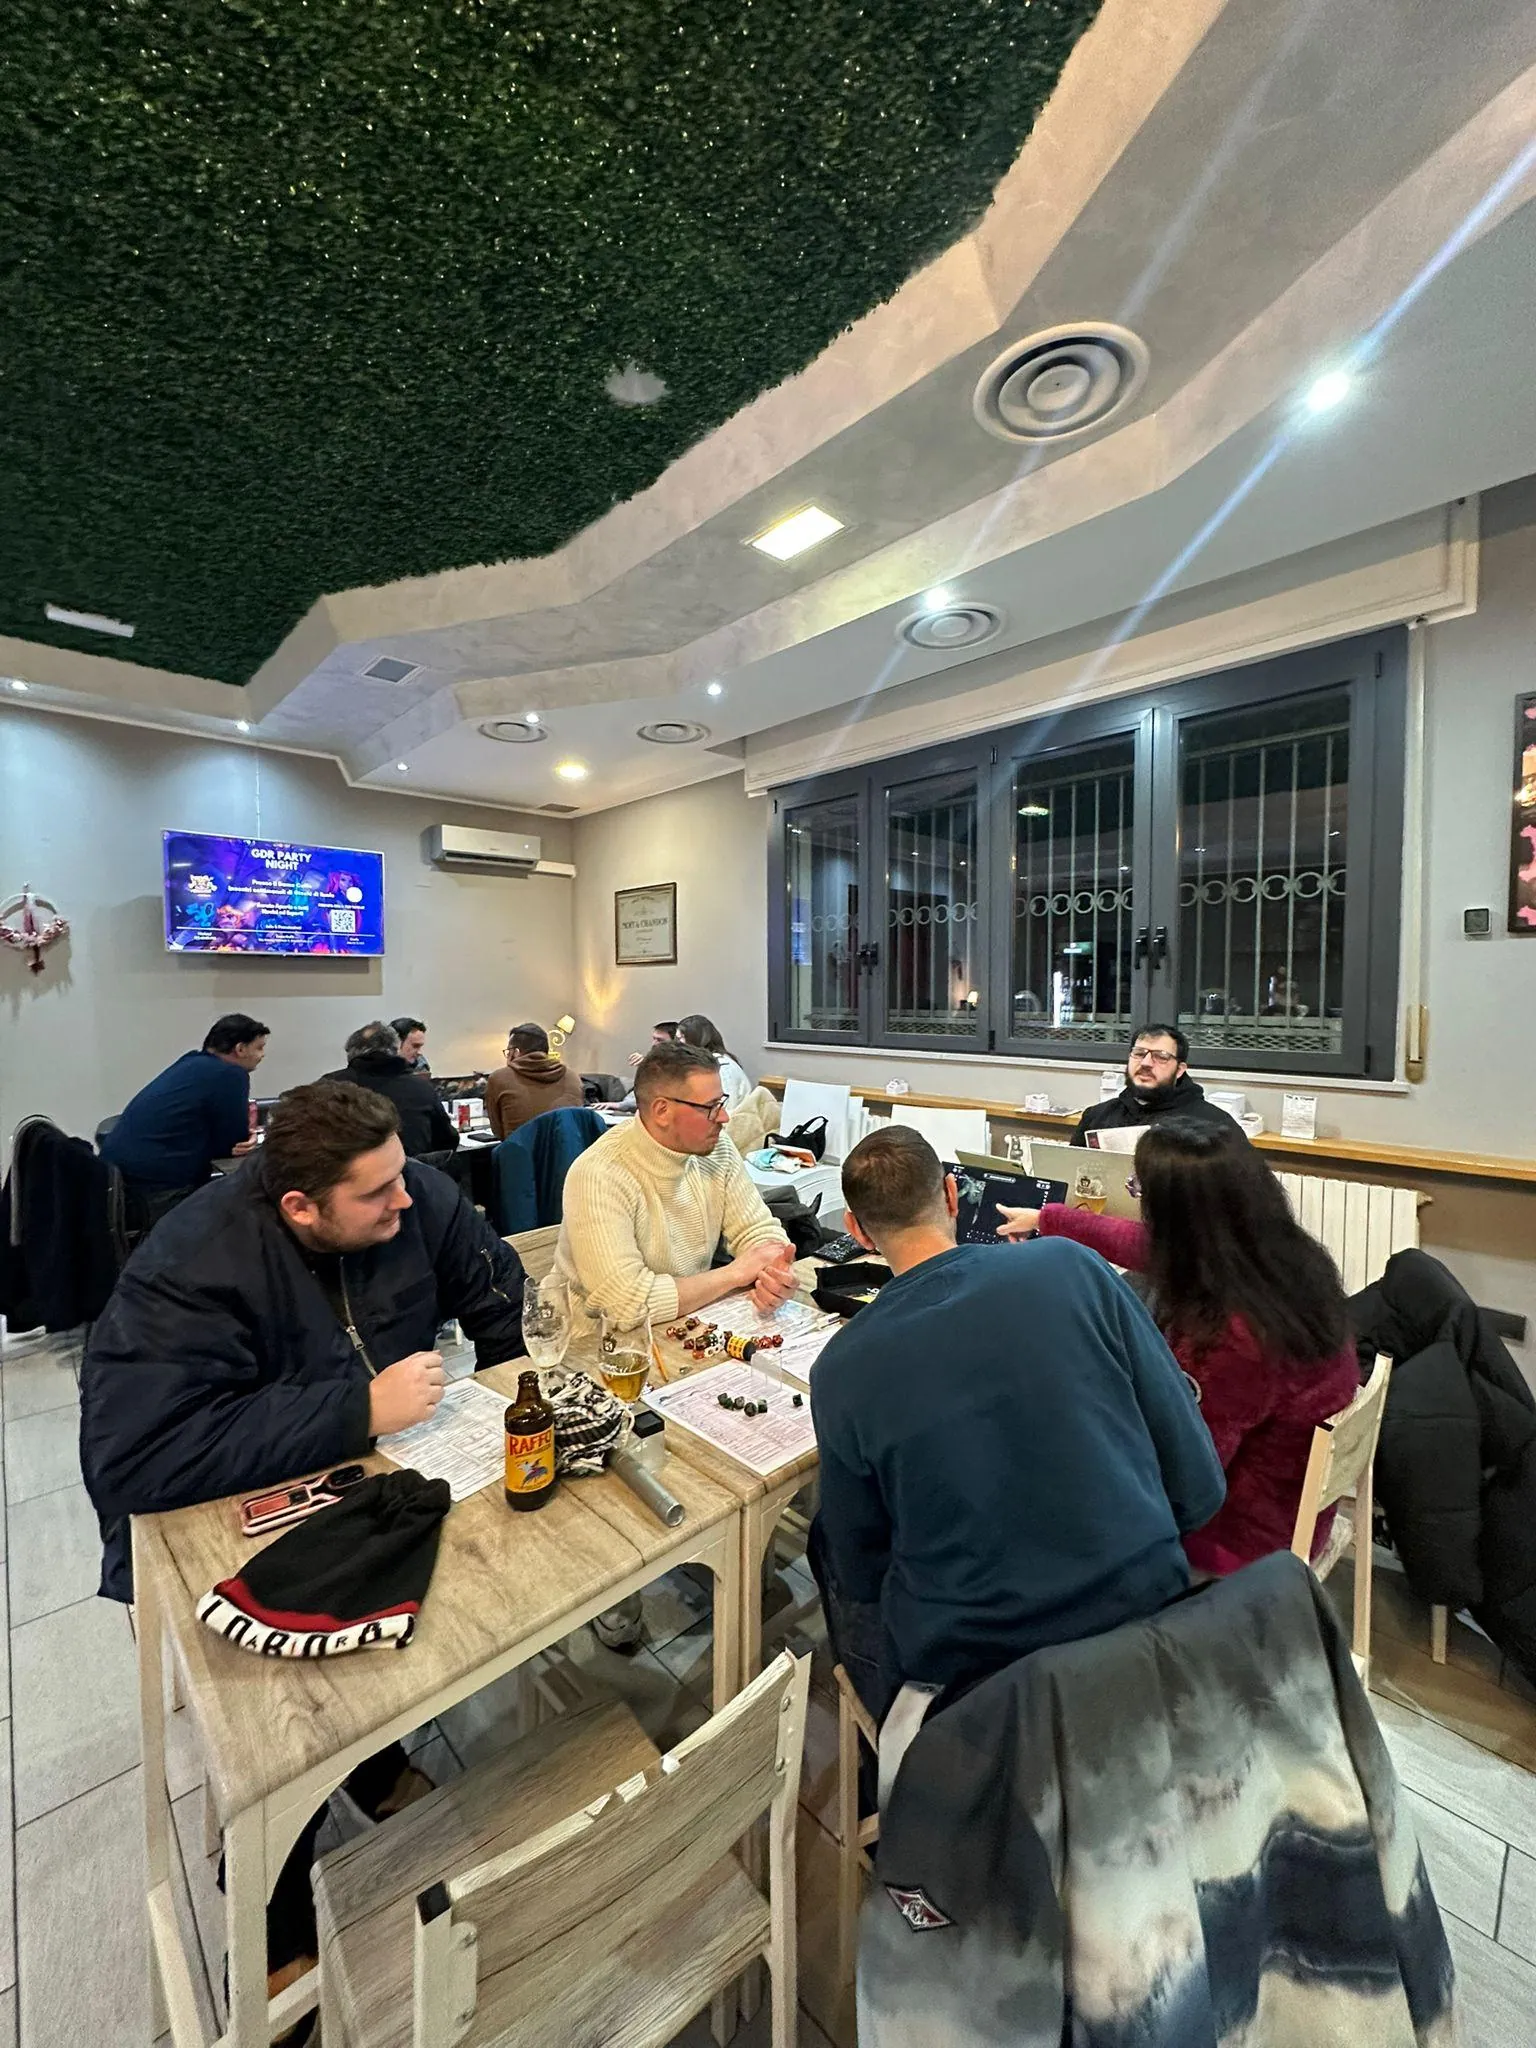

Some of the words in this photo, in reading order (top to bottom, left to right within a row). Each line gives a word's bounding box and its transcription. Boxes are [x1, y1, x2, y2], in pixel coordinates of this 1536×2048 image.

[251, 849, 275, 859] GDR
[277, 850, 312, 863] PARTY
[265, 859, 299, 870] NIGHT
